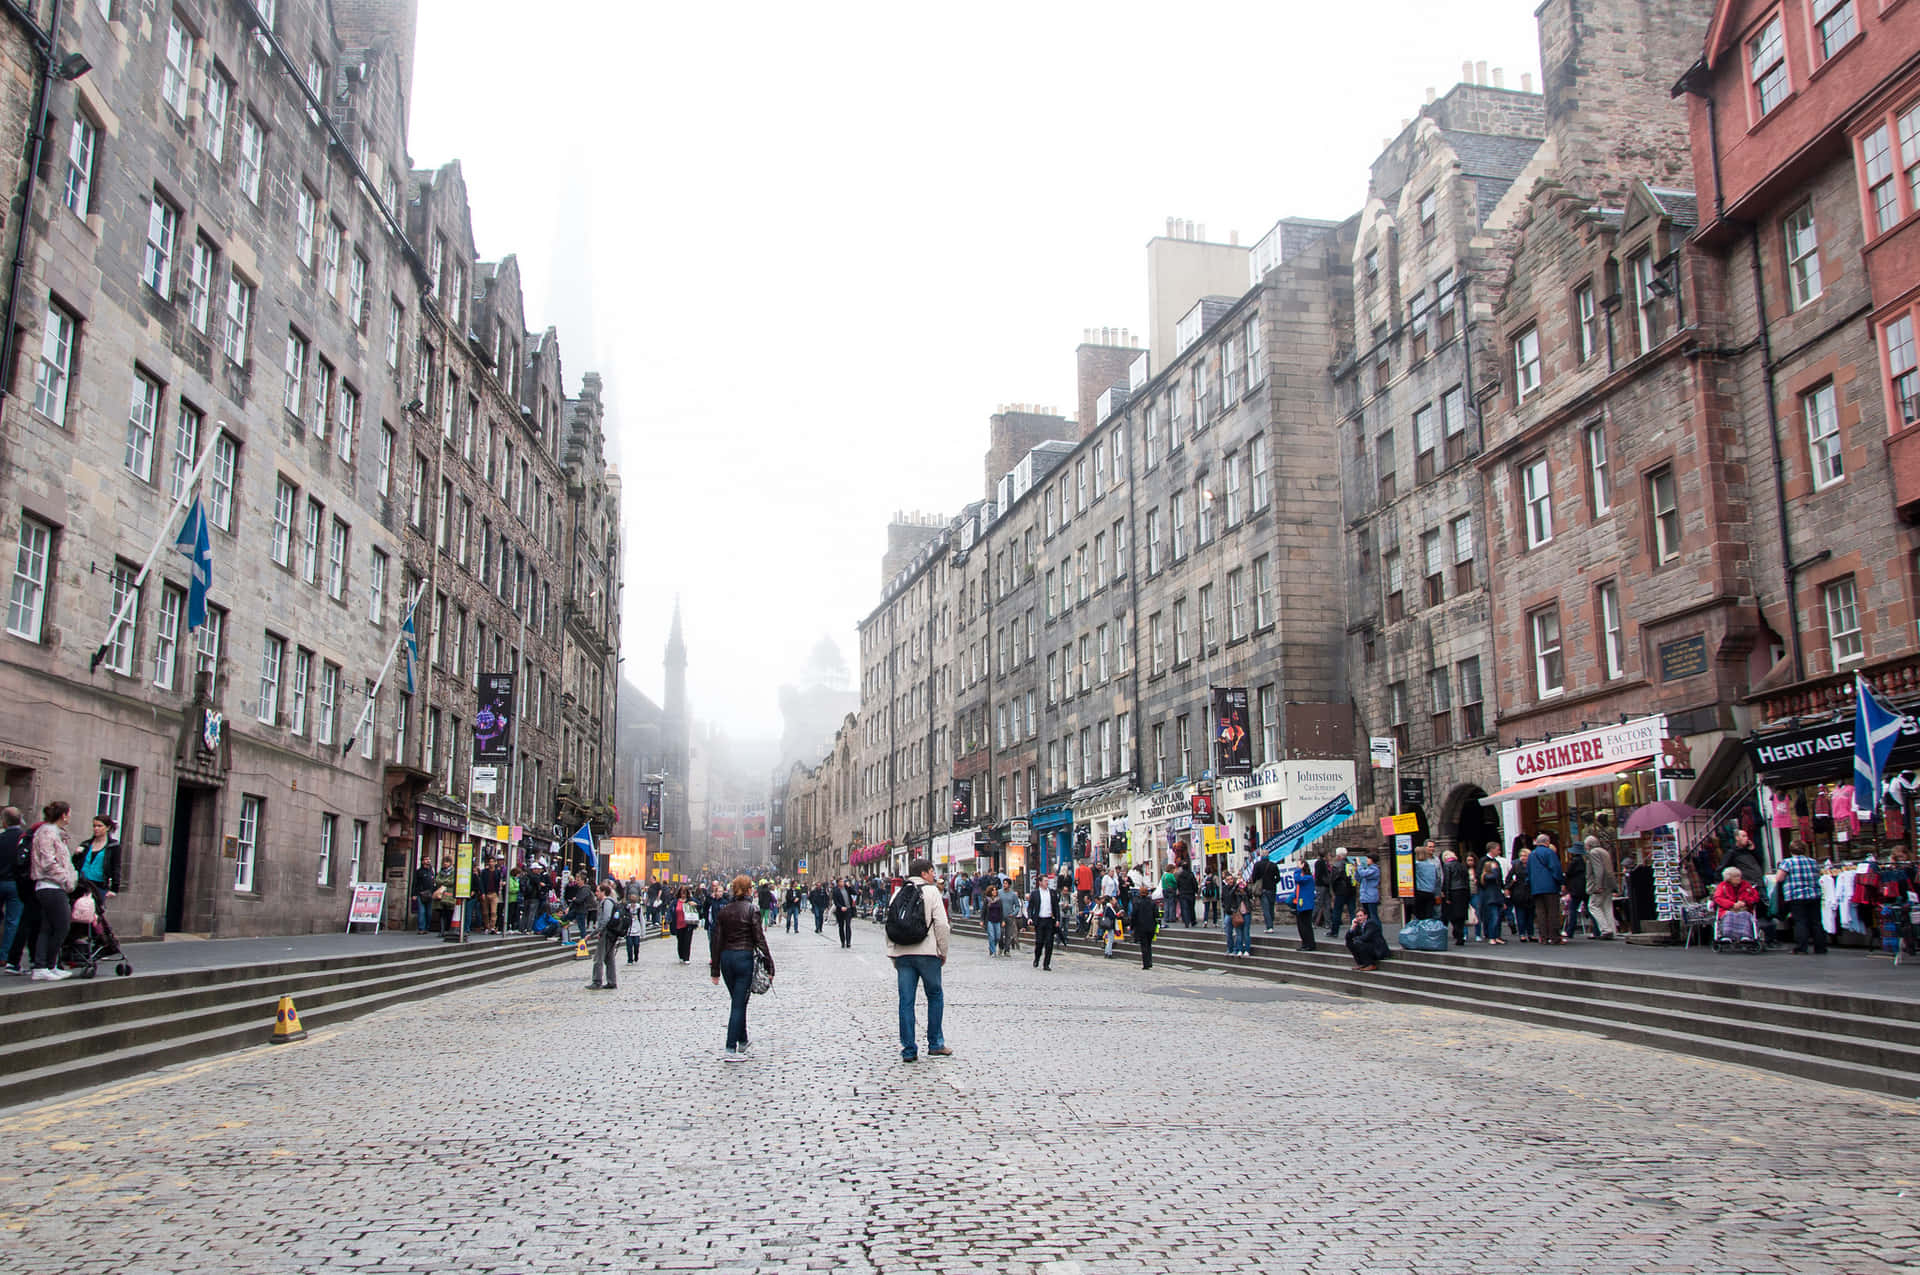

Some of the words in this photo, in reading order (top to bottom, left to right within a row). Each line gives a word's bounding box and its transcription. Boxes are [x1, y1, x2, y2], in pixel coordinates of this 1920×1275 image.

[1606, 726, 1654, 745] FACTORY
[1757, 731, 1856, 764] HERITAGE
[1899, 714, 1920, 735] S
[1516, 738, 1604, 776] CASHMERE
[1611, 739, 1654, 756] OUTLET
[1226, 768, 1279, 793] CASHMERE
[1297, 770, 1344, 783] Johnstons
[1151, 791, 1185, 807] SCOTLAND
[1140, 810, 1146, 820] T
[1147, 805, 1166, 818] SHIRT
[1167, 799, 1193, 815] COMPAN
[1279, 875, 1295, 891] 16
